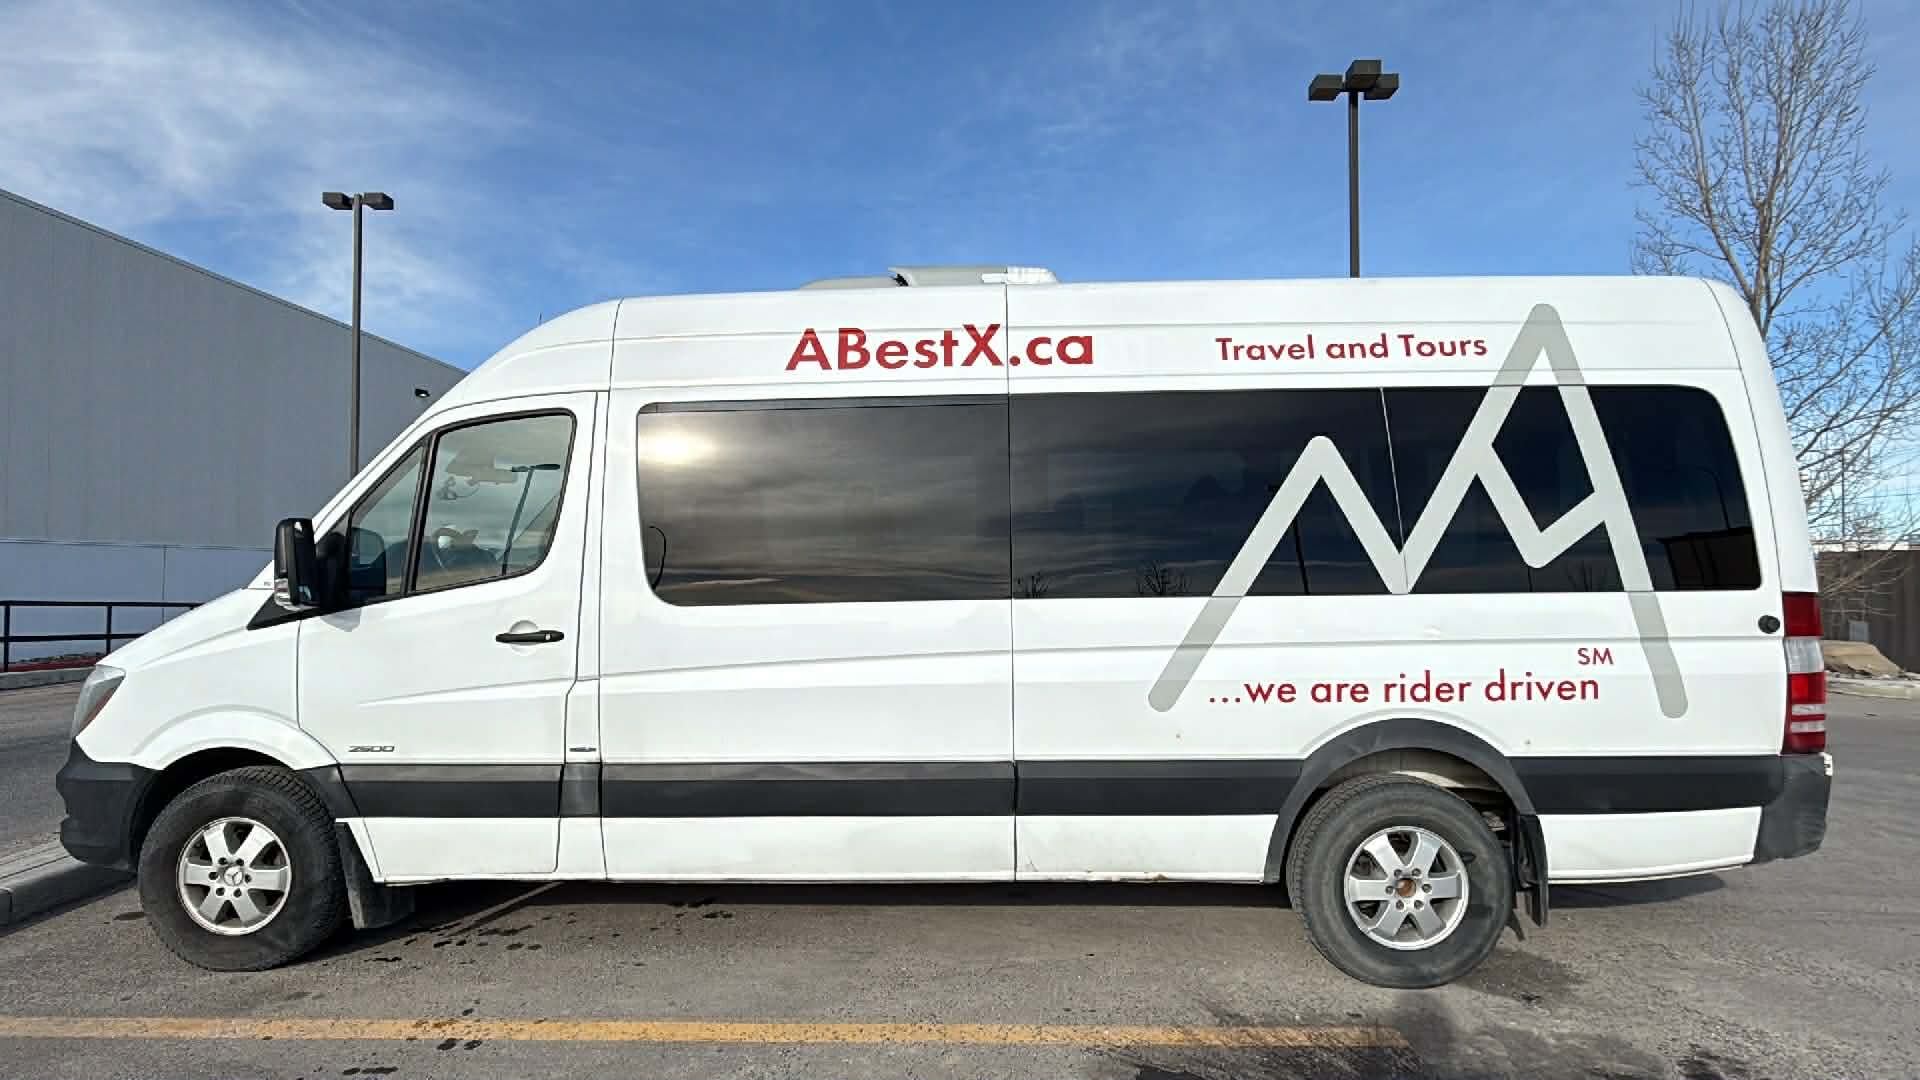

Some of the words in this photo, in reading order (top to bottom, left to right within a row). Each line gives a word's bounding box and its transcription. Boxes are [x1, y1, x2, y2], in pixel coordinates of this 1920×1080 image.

[785, 324, 1094, 371] ABestX.ca
[1215, 334, 1315, 361] Travel
[1326, 333, 1389, 359] and
[1397, 334, 1488, 357] Tours
[1577, 647, 1614, 665] SM
[1311, 682, 1369, 704] are
[1384, 670, 1472, 703] rider
[1484, 669, 1599, 702] driven
[348, 745, 395, 753] 2500
